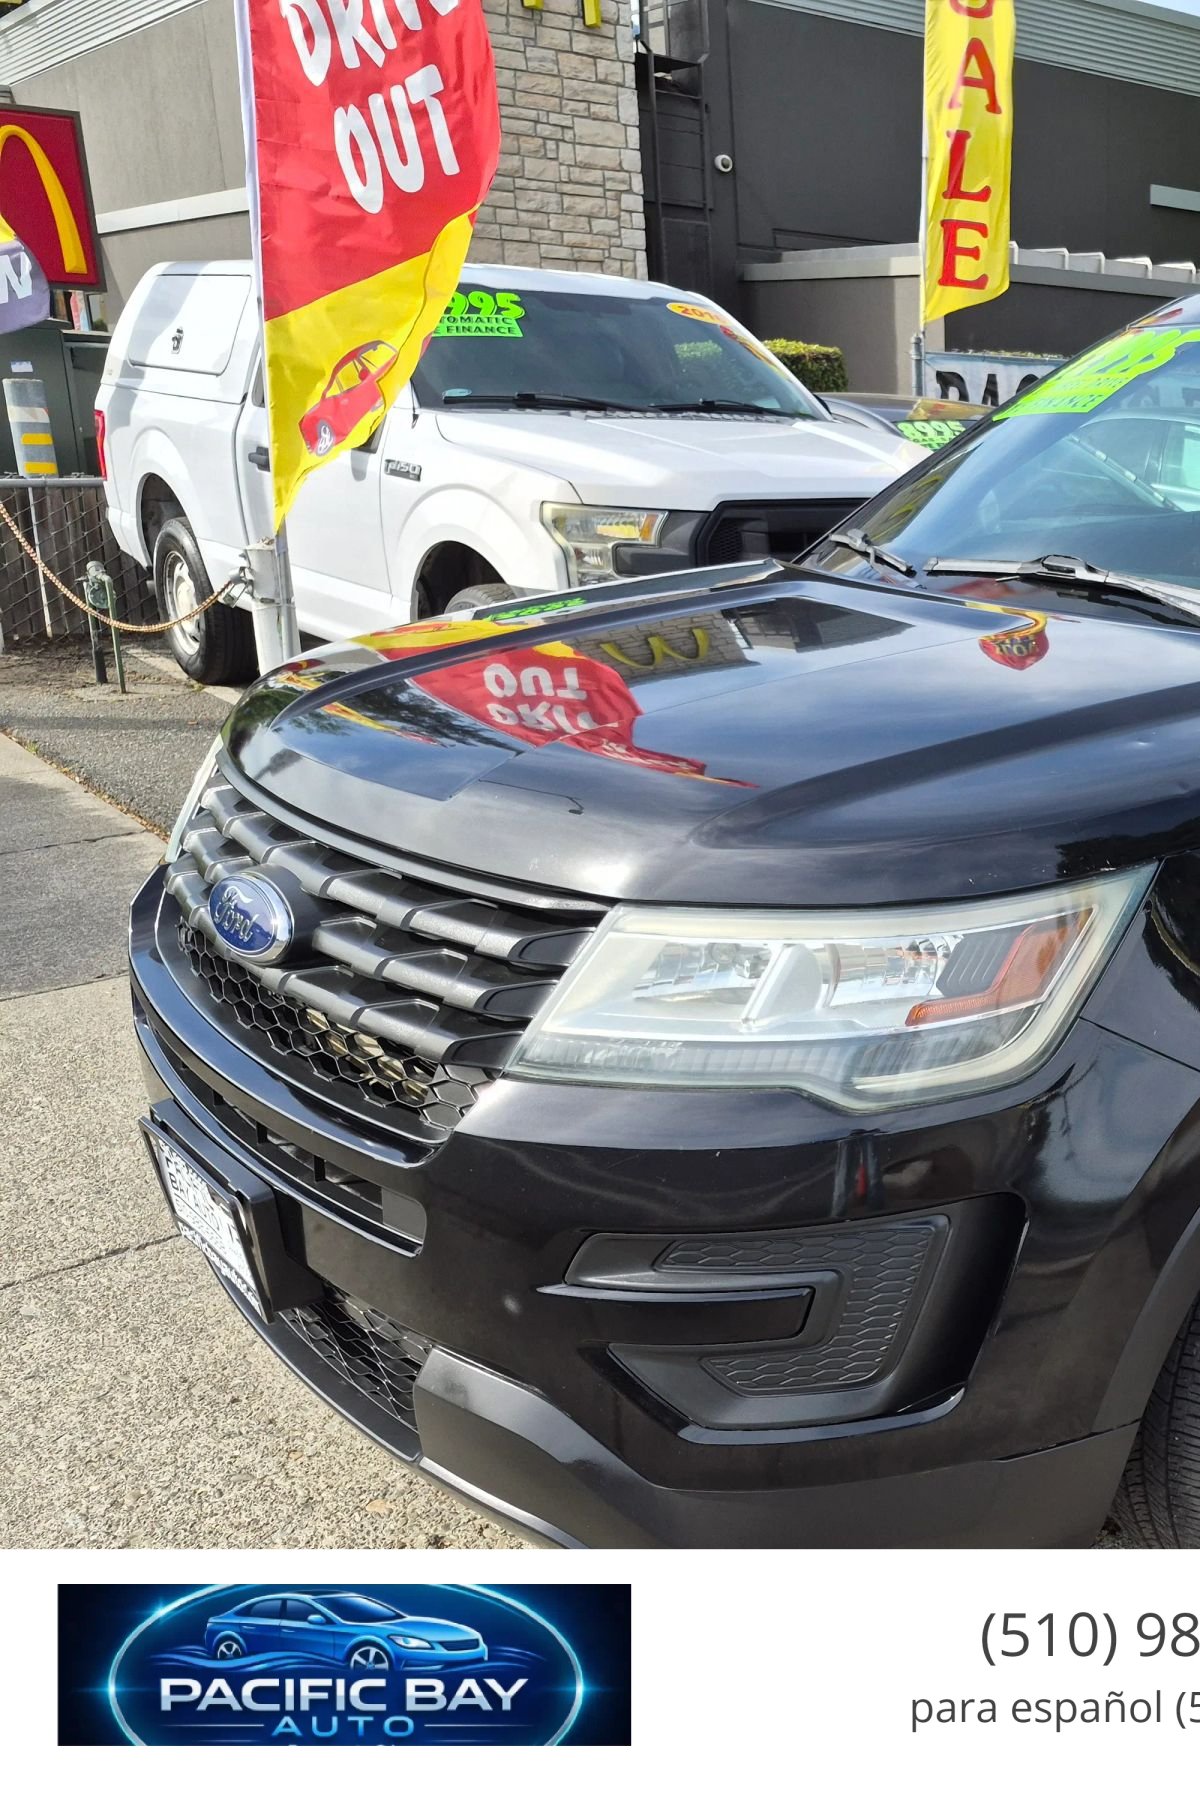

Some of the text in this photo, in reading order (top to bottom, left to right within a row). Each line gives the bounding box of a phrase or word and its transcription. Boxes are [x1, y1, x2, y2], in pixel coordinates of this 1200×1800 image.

[334, 64, 460, 214] OUT
[938, 0, 1002, 290] ALE
[446, 325, 516, 335] FINANCE
[214, 886, 259, 942] Ford
